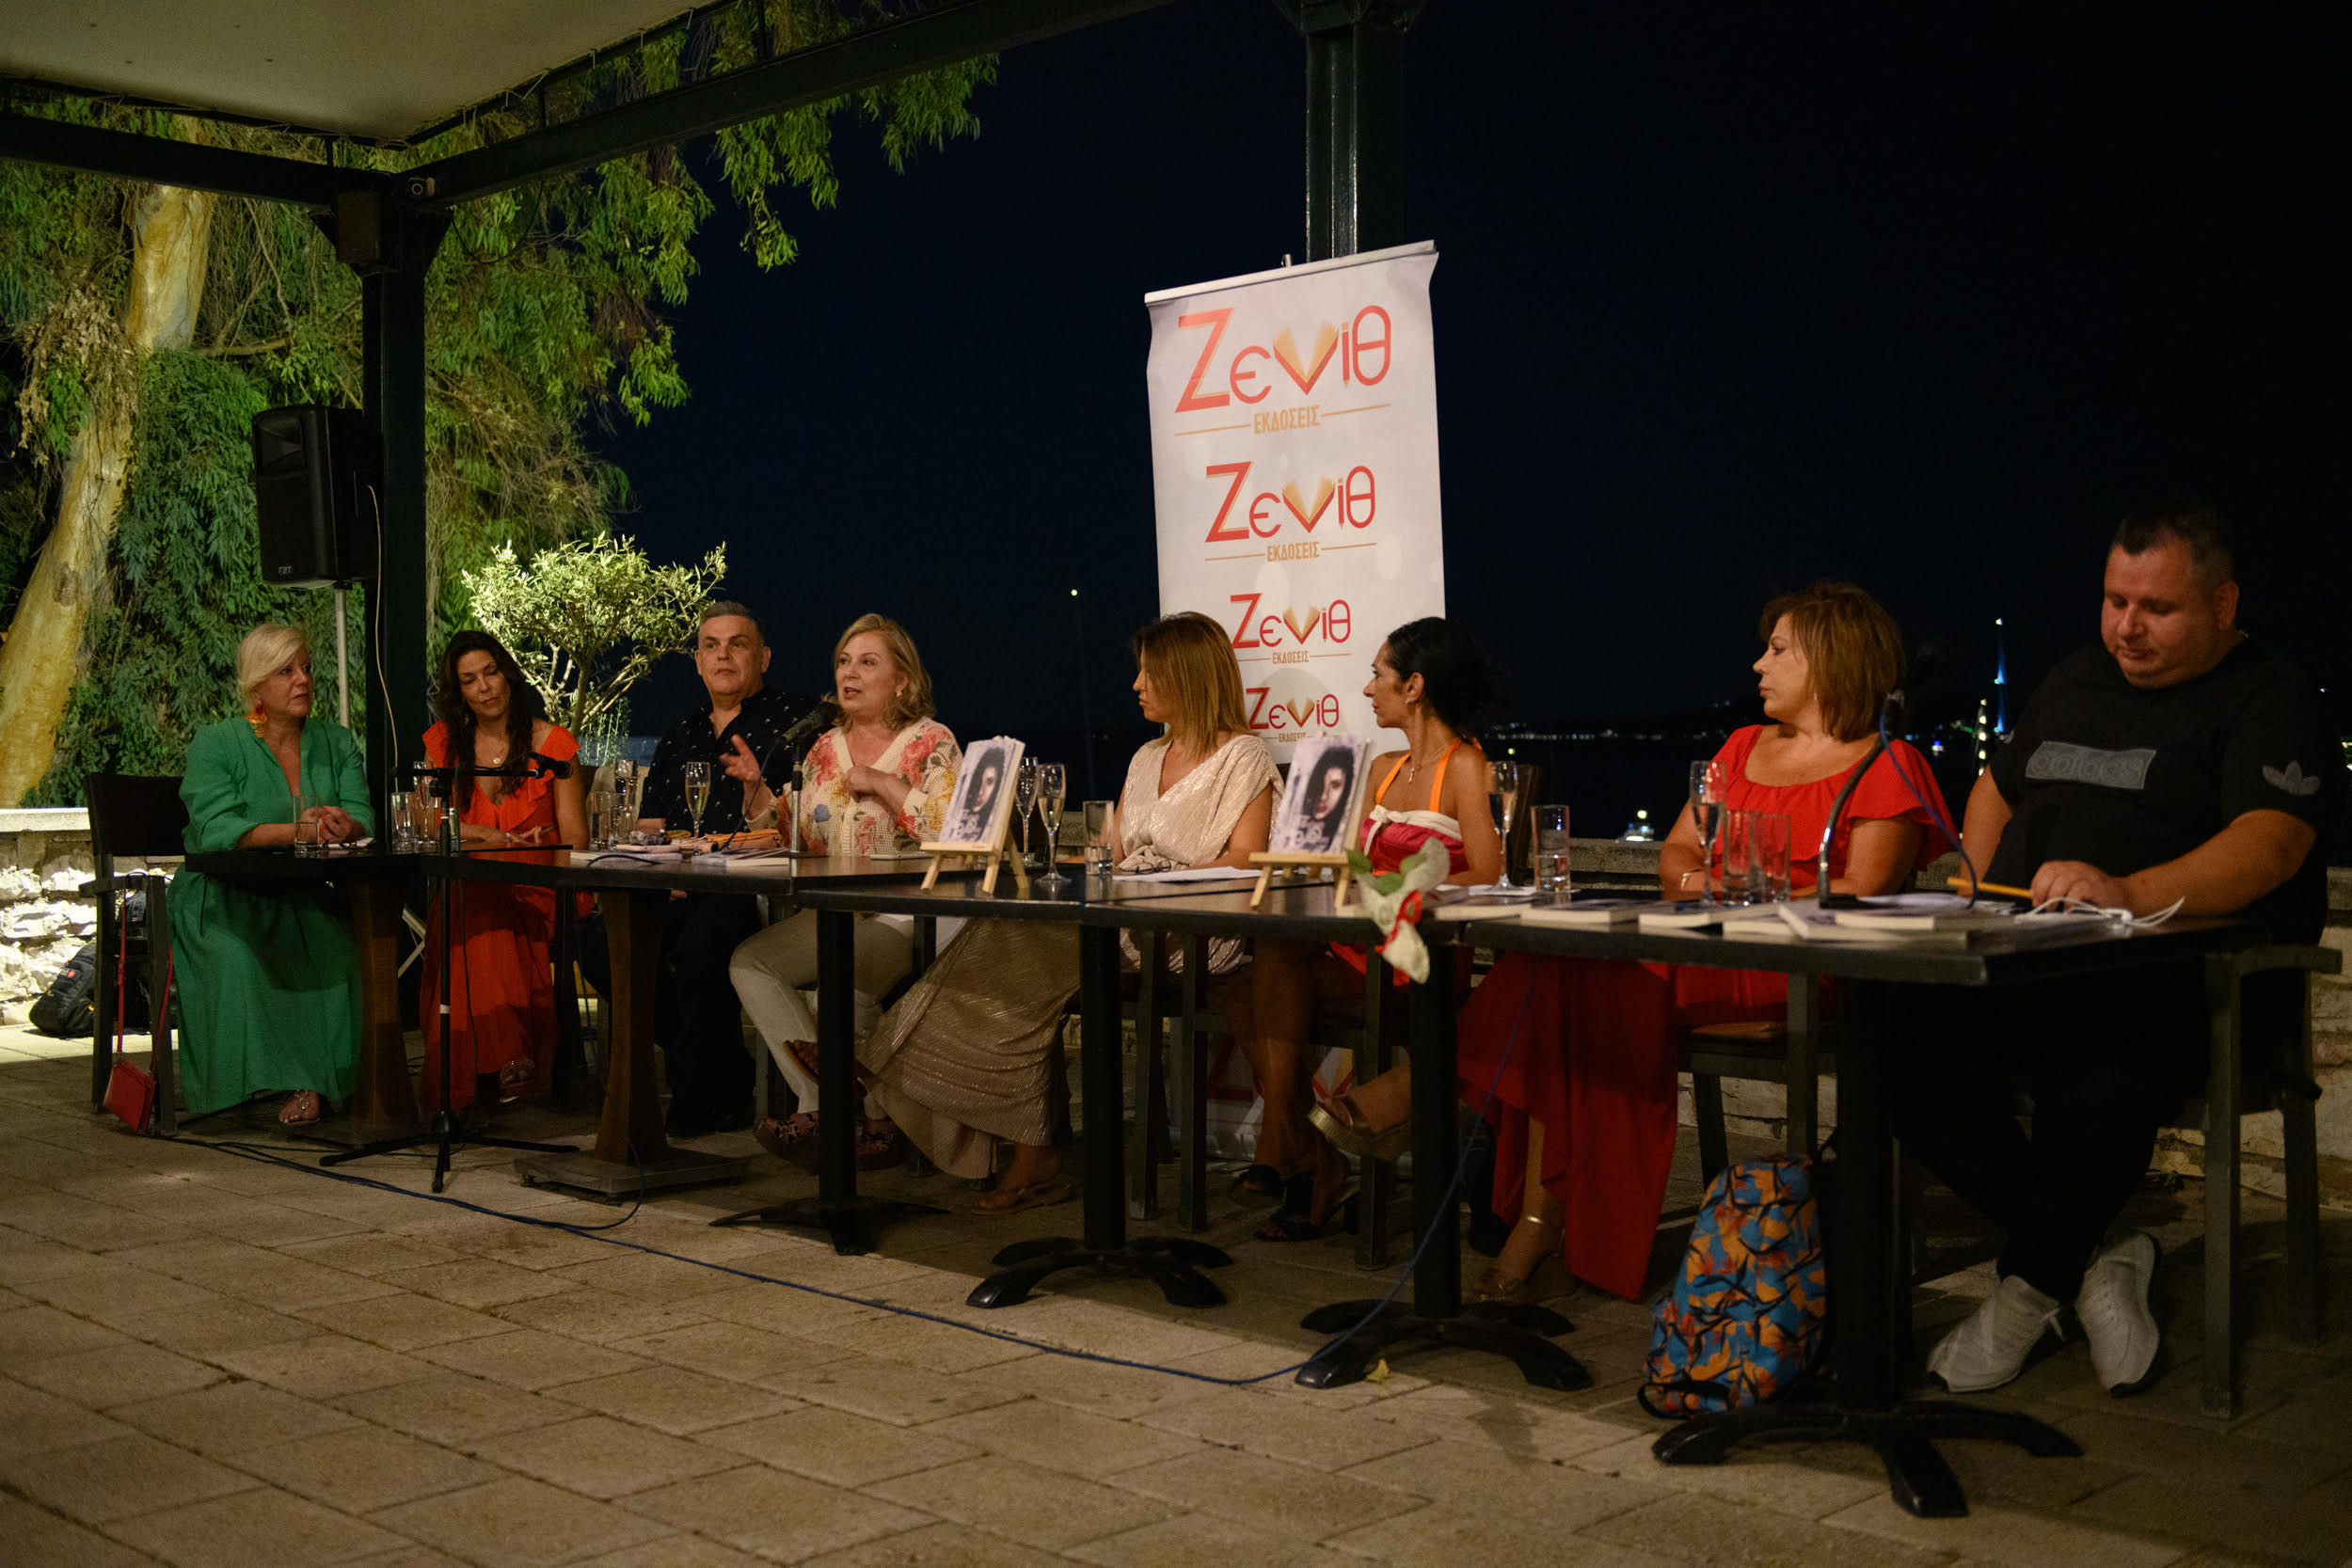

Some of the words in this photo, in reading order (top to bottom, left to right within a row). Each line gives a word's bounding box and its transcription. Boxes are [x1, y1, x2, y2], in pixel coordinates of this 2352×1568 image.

[1253, 404, 1320, 435] ΕΚΔΟΣΕΙΣ
[1266, 541, 1320, 562] ΕΚΔΟΣΕΙΣ
[1272, 651, 1310, 664] ΕΚΔΟΣΕΙΣ
